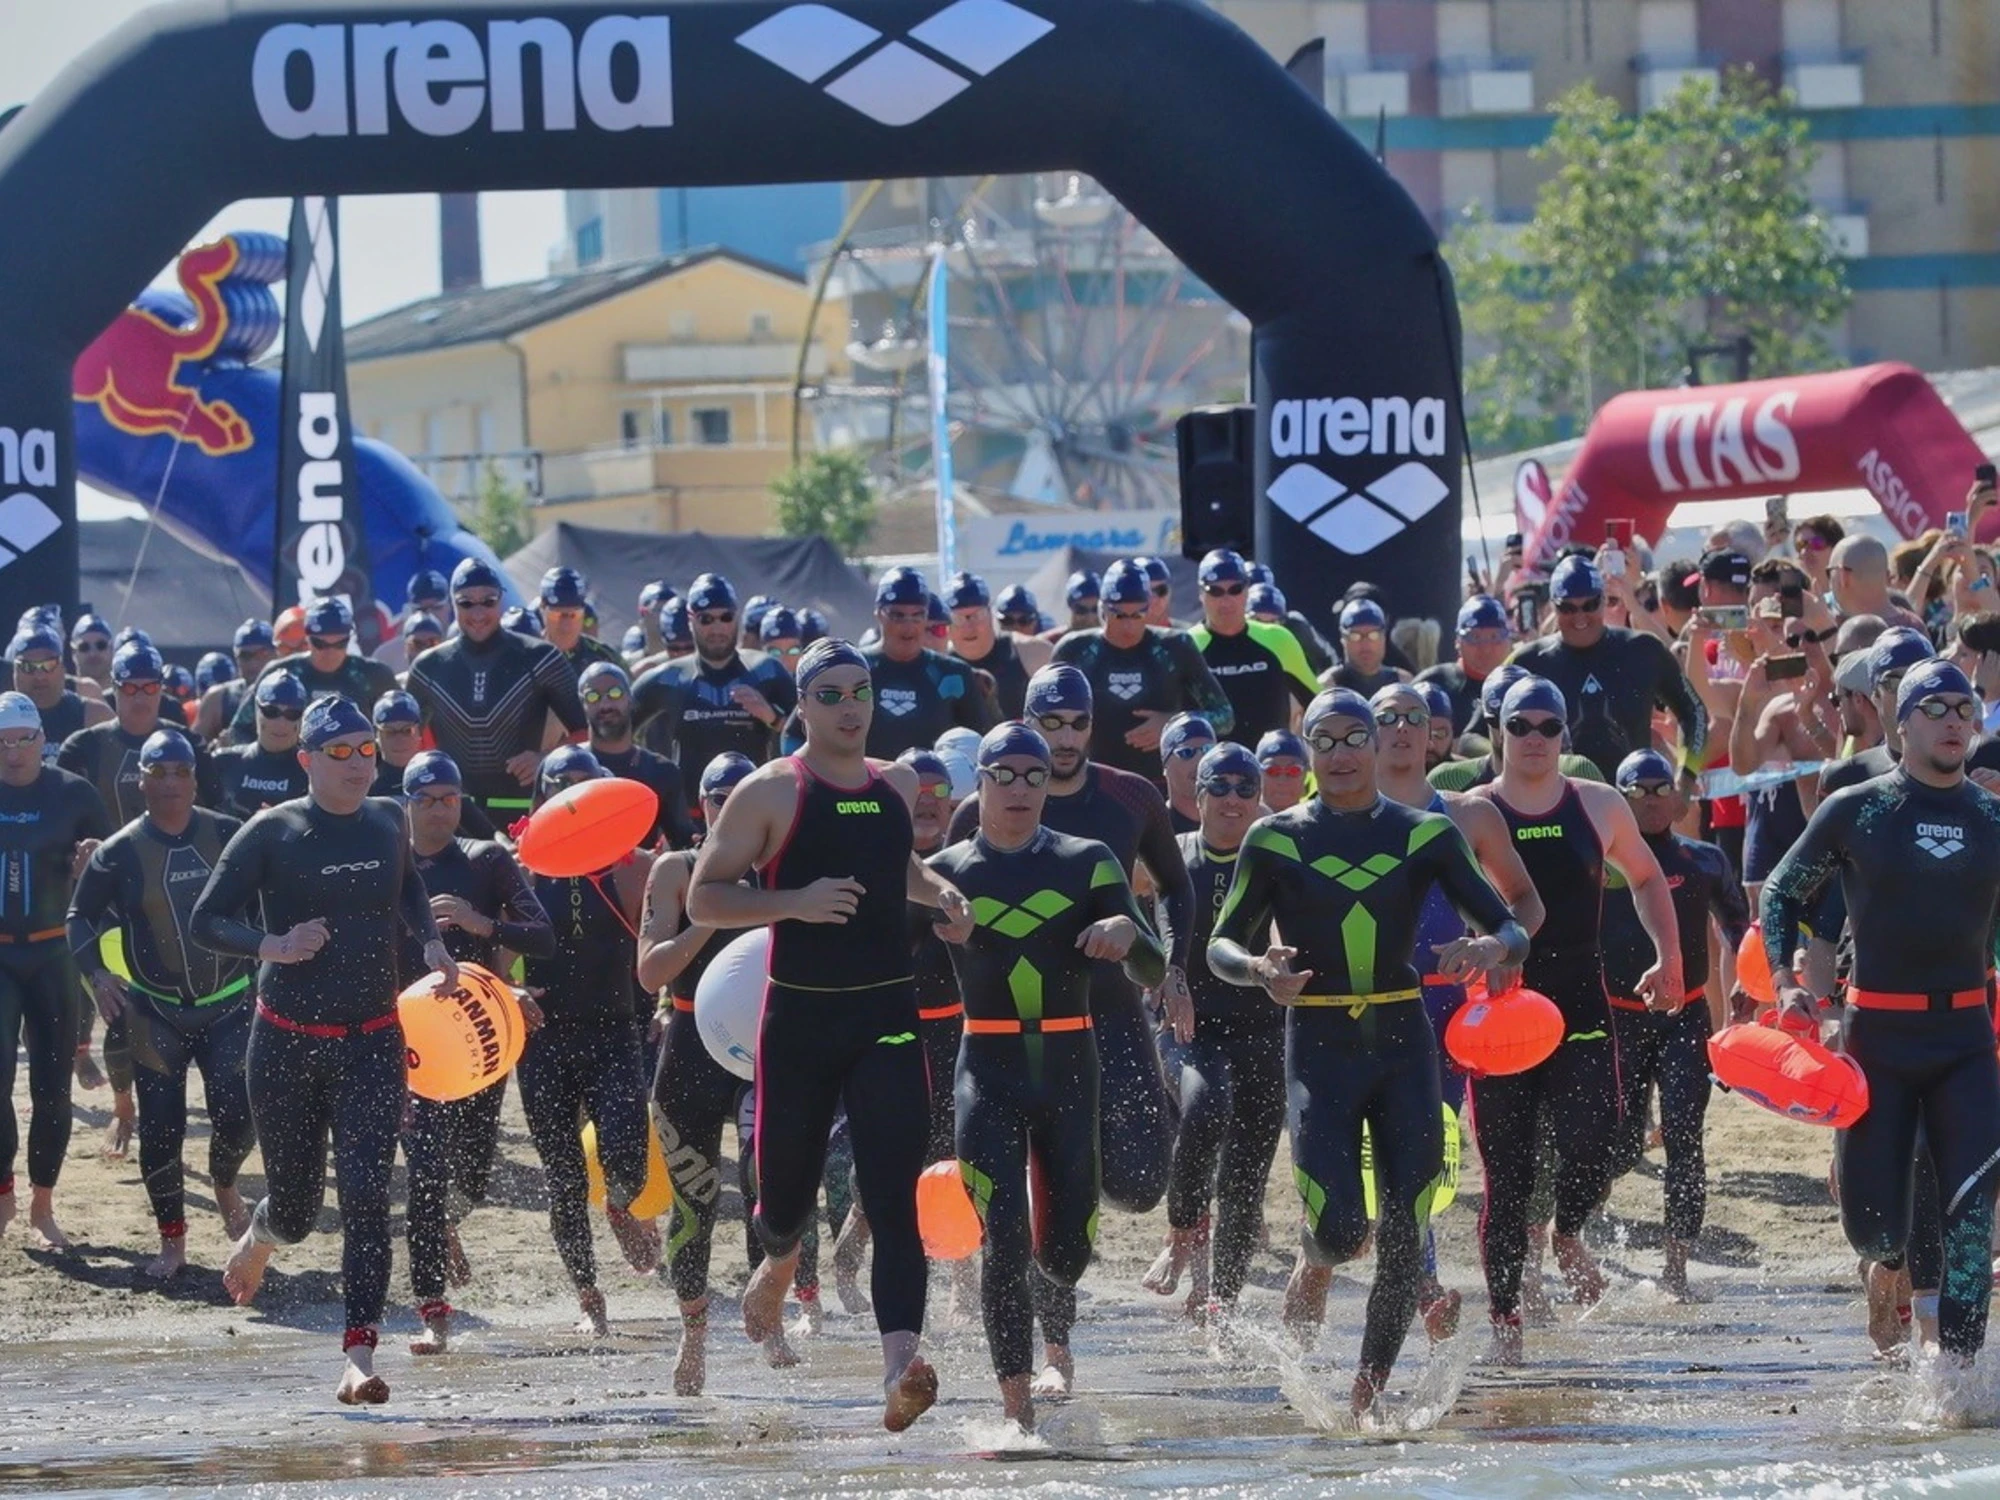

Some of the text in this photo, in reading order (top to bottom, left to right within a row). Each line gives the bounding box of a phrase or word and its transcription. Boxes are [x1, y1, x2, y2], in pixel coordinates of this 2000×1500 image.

[252, 15, 674, 139] arena
[1271, 396, 1445, 458] arena
[1649, 391, 1801, 492] ITAS
[1207, 661, 1268, 676] HEAD
[1108, 672, 1142, 684] arena
[880, 688, 916, 700] arena
[241, 775, 289, 792] Jaked
[836, 801, 881, 814] arena
[1517, 825, 1562, 840] arena
[1916, 822, 1964, 840] arena
[321, 860, 380, 875] orca
[451, 987, 500, 1077] ANMAN
